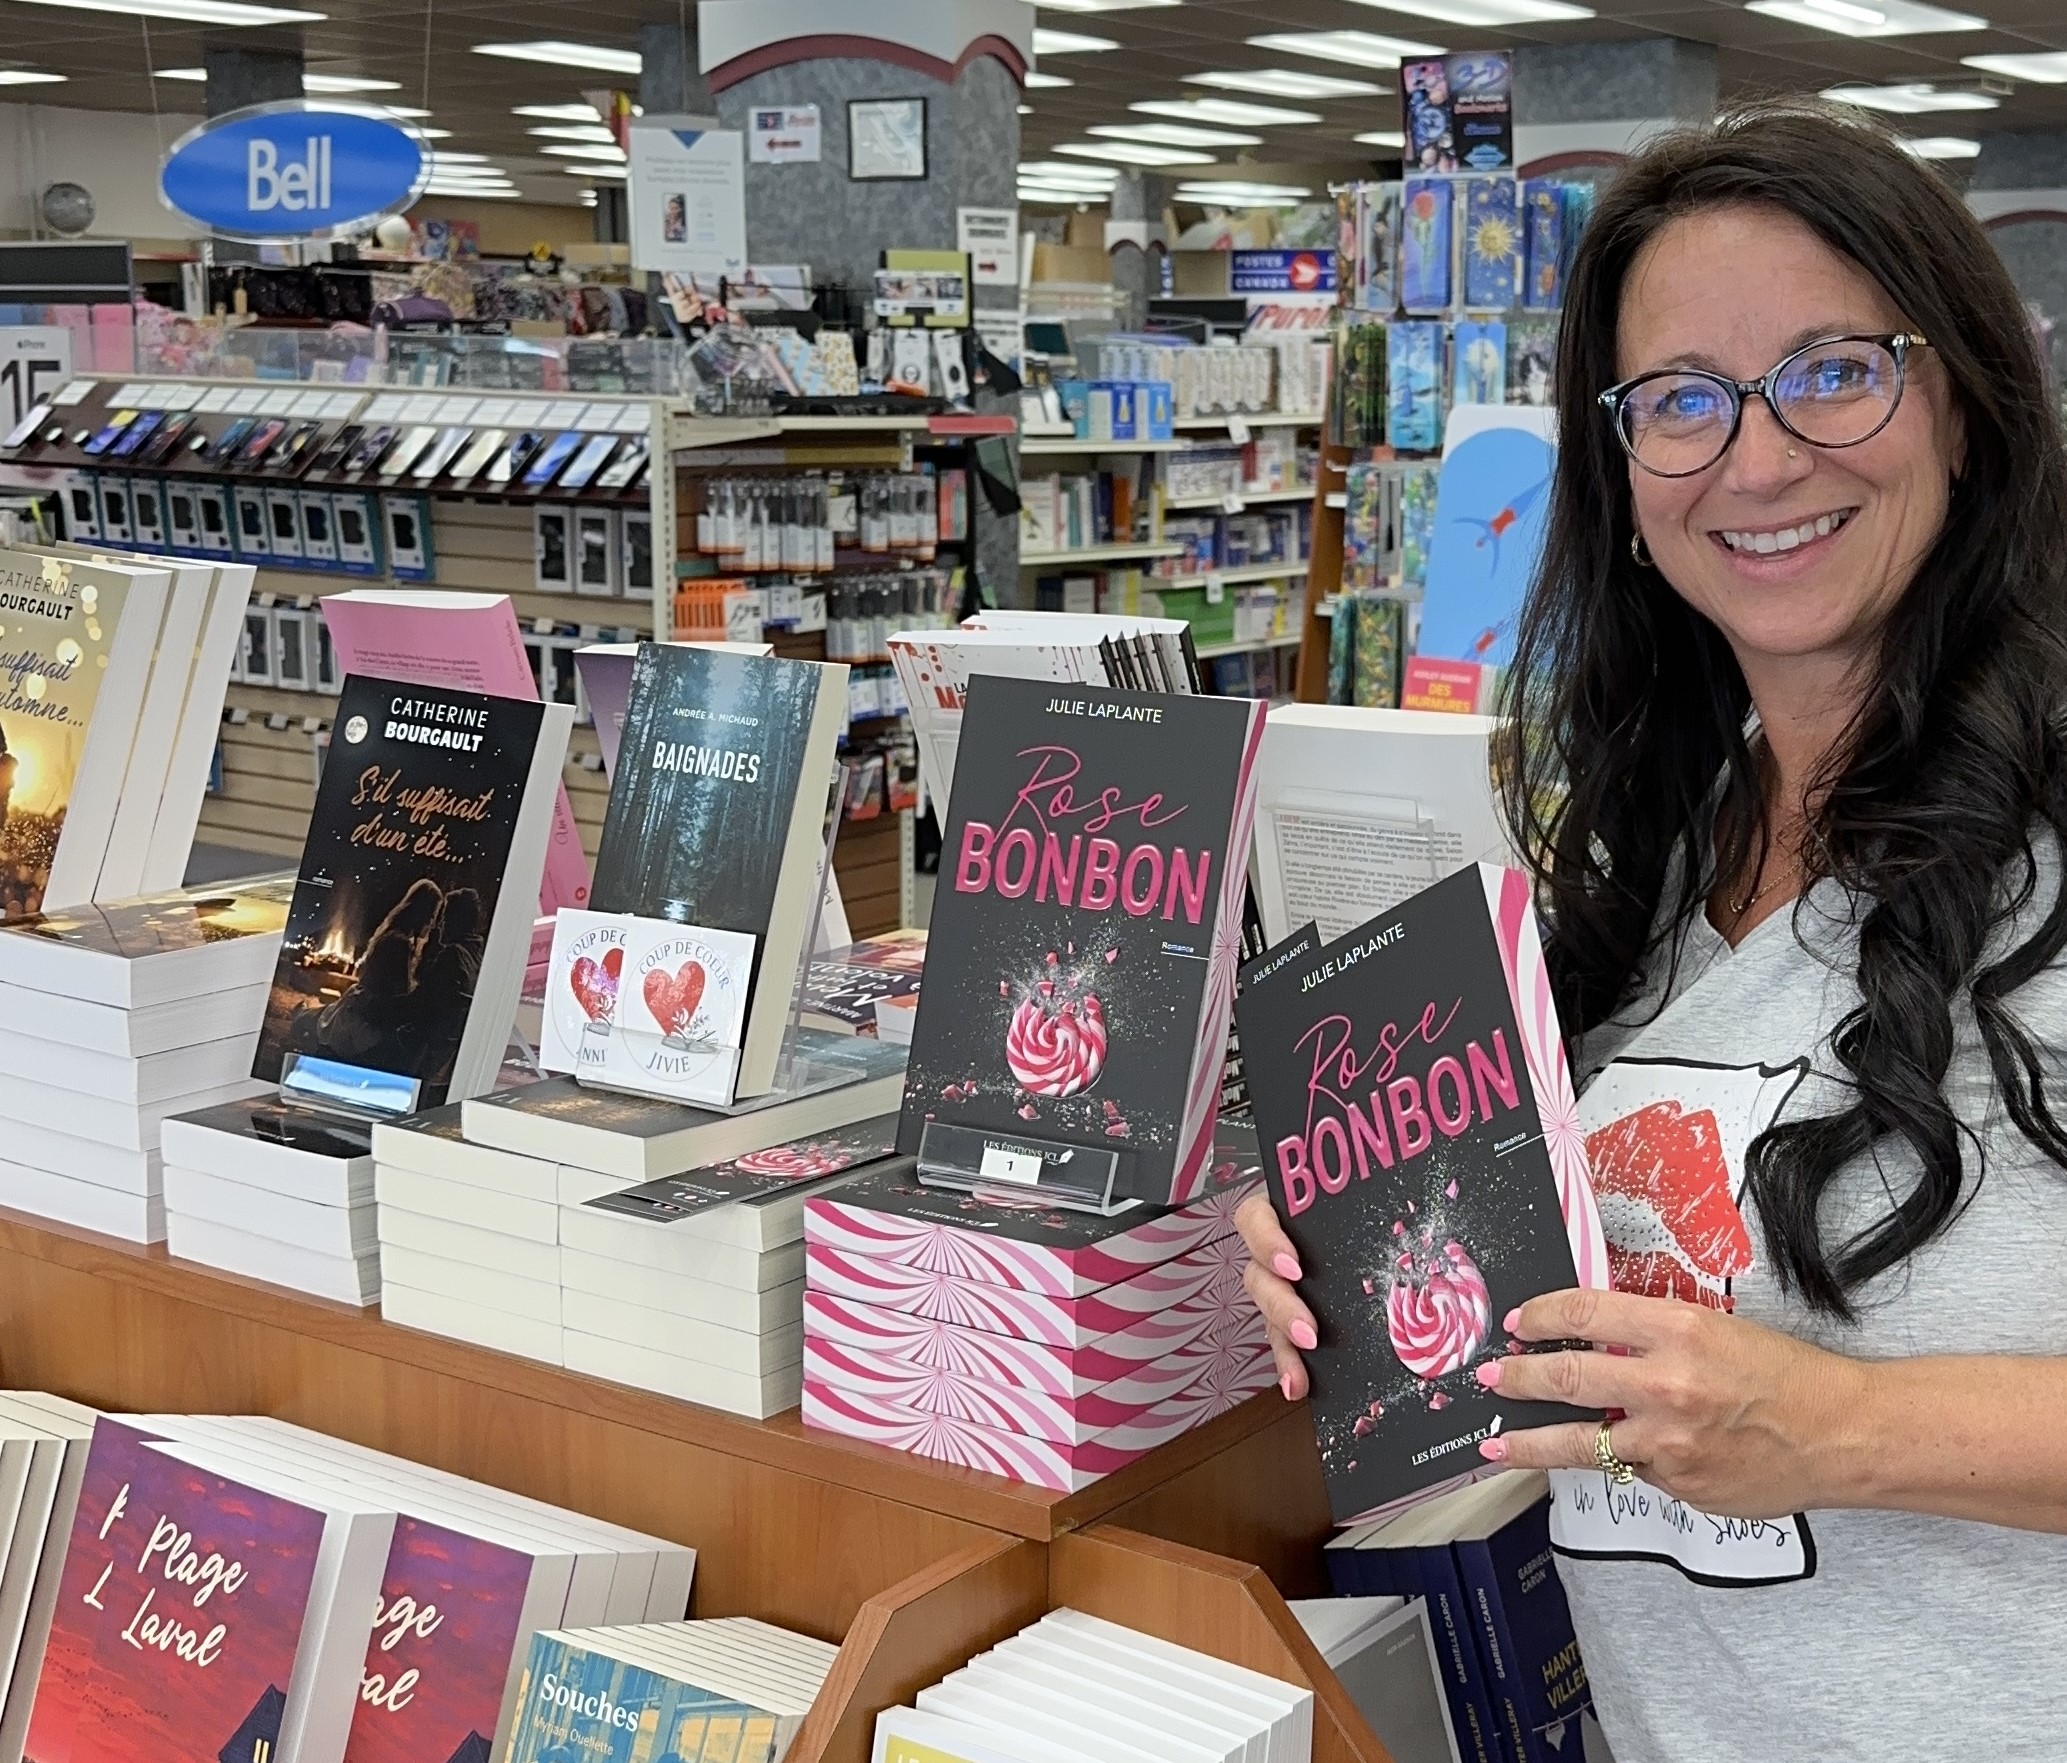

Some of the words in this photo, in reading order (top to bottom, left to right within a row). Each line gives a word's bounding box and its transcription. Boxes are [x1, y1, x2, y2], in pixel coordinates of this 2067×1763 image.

[247, 136, 332, 211] Bell
[1235, 255, 1283, 267] POSTES
[1235, 277, 1289, 288] CANADA
[0, 593, 73, 621] OURGAULT
[1406, 694, 1471, 713] MURMURES
[1428, 682, 1452, 697] DES
[390, 697, 489, 729] CATHERINE
[708, 711, 717, 722] A.
[719, 713, 759, 728] MICHAUD
[1046, 698, 1085, 716] JULIE
[1088, 701, 1163, 724] LAPLANTE
[384, 720, 484, 753] BOURGAULT
[652, 740, 761, 784] BAIGNADES
[351, 764, 402, 807] S'il
[396, 785, 495, 826] suffisait
[992, 745, 1190, 845] Rose
[351, 813, 408, 852] d'un
[955, 820, 1212, 925] BONBON
[566, 932, 597, 964] COUP
[600, 929, 616, 943] DE
[639, 944, 671, 976] COUP
[675, 941, 692, 955] DE
[1161, 941, 1196, 954] Romance
[1252, 965, 1273, 985] JULIE
[1271, 940, 1310, 974] LAPLANTE
[1301, 962, 1336, 993] JULIE
[1337, 922, 1406, 973] LAPLANTE
[646, 1051, 691, 1074] JIVIE
[1293, 995, 1463, 1150] Rose
[1276, 1026, 1521, 1218] BONBON
[983, 1139, 1001, 1152] LES
[1493, 1132, 1527, 1152] Romance
[1006, 1160, 1015, 1173] 1
[1411, 1450, 1429, 1466] LES
[1429, 1434, 1473, 1462] ÉDITIONS
[137, 1514, 249, 1608] Plage
[1521, 1569, 1547, 1593] CARON
[1439, 1592, 1453, 1628] CARON
[1477, 1587, 1492, 1624] CARON
[121, 1587, 227, 1668] Laval
[1447, 1628, 1468, 1684] GABRIELLE
[1483, 1624, 1506, 1680] GABRIELLE
[540, 1672, 640, 1733] Souches
[533, 1714, 568, 1742] Myriam
[570, 1729, 615, 1757] Ouellette
[1465, 1702, 1484, 1752] VILLERAY
[1503, 1697, 1522, 1745] VILLERAY
